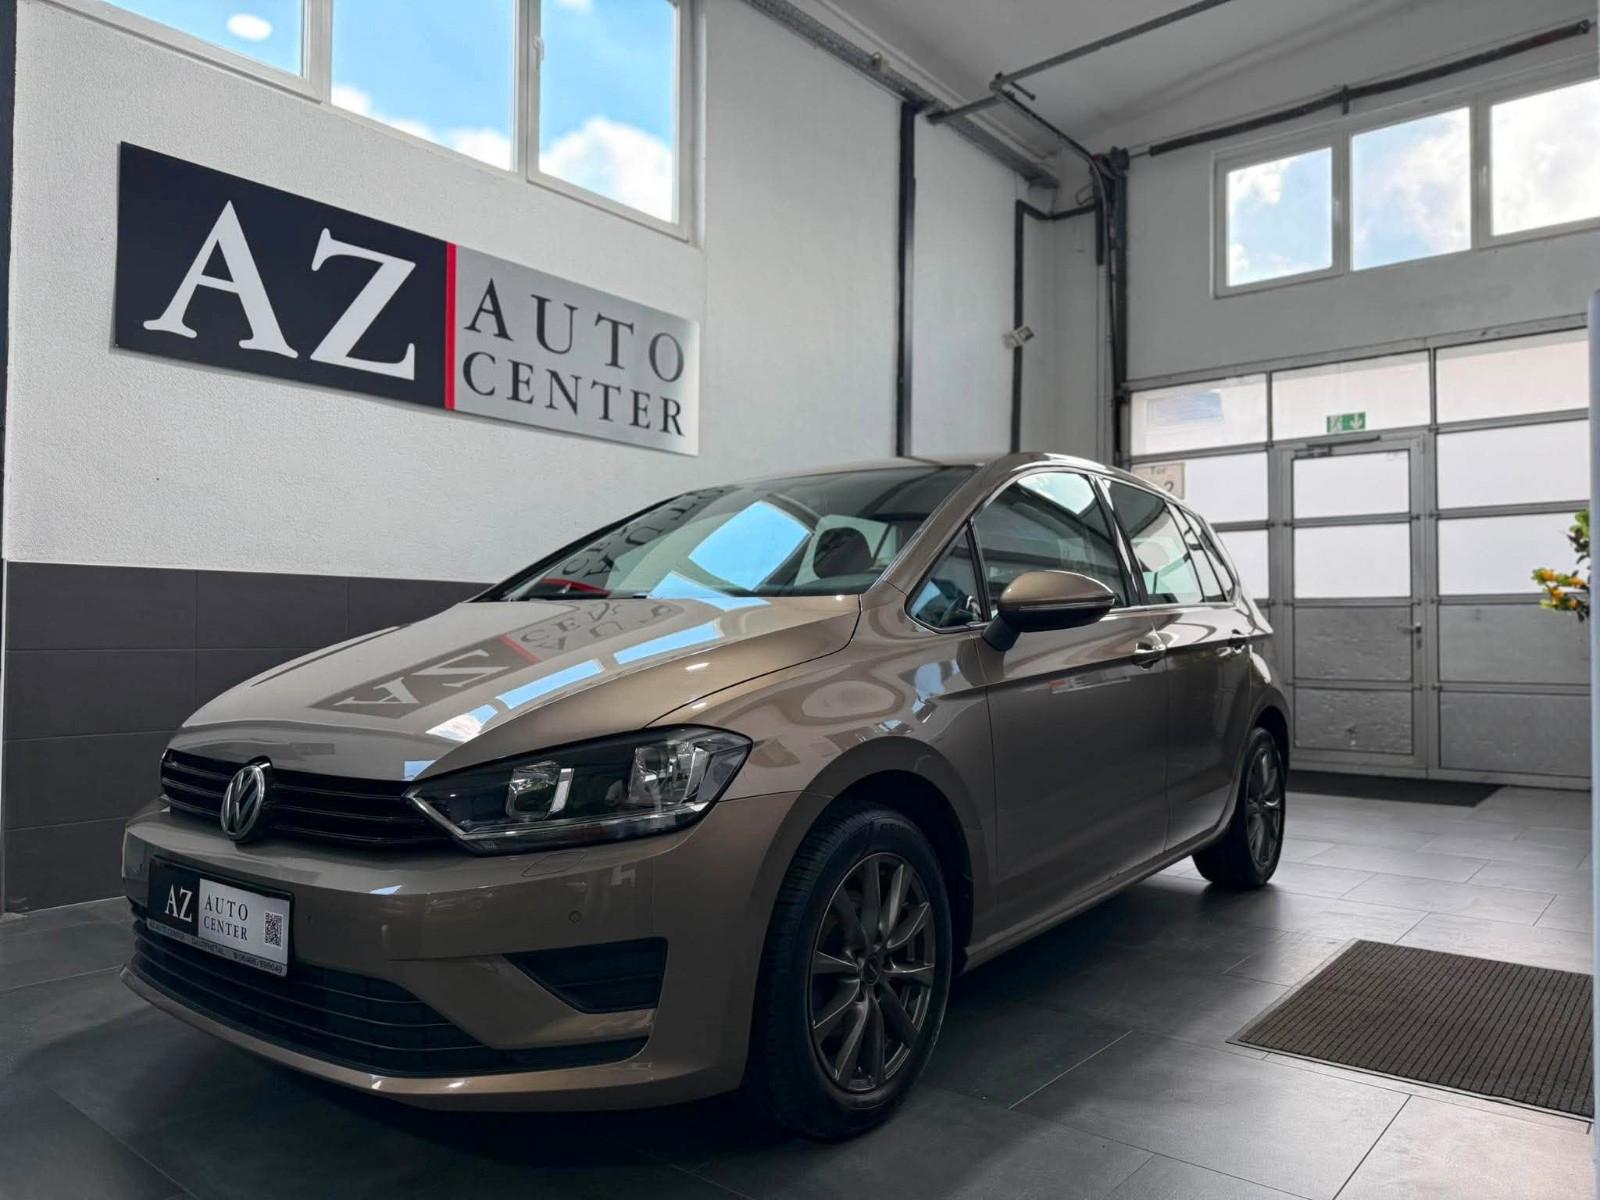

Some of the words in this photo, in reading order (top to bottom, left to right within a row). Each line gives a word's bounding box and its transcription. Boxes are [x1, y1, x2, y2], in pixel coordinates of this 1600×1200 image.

[143, 200, 416, 380] AZ
[463, 277, 685, 383] AUTO
[463, 351, 686, 437] CENTER
[164, 884, 192, 922] AZ
[203, 916, 248, 941] CENTER
[204, 893, 248, 922] AUTO
